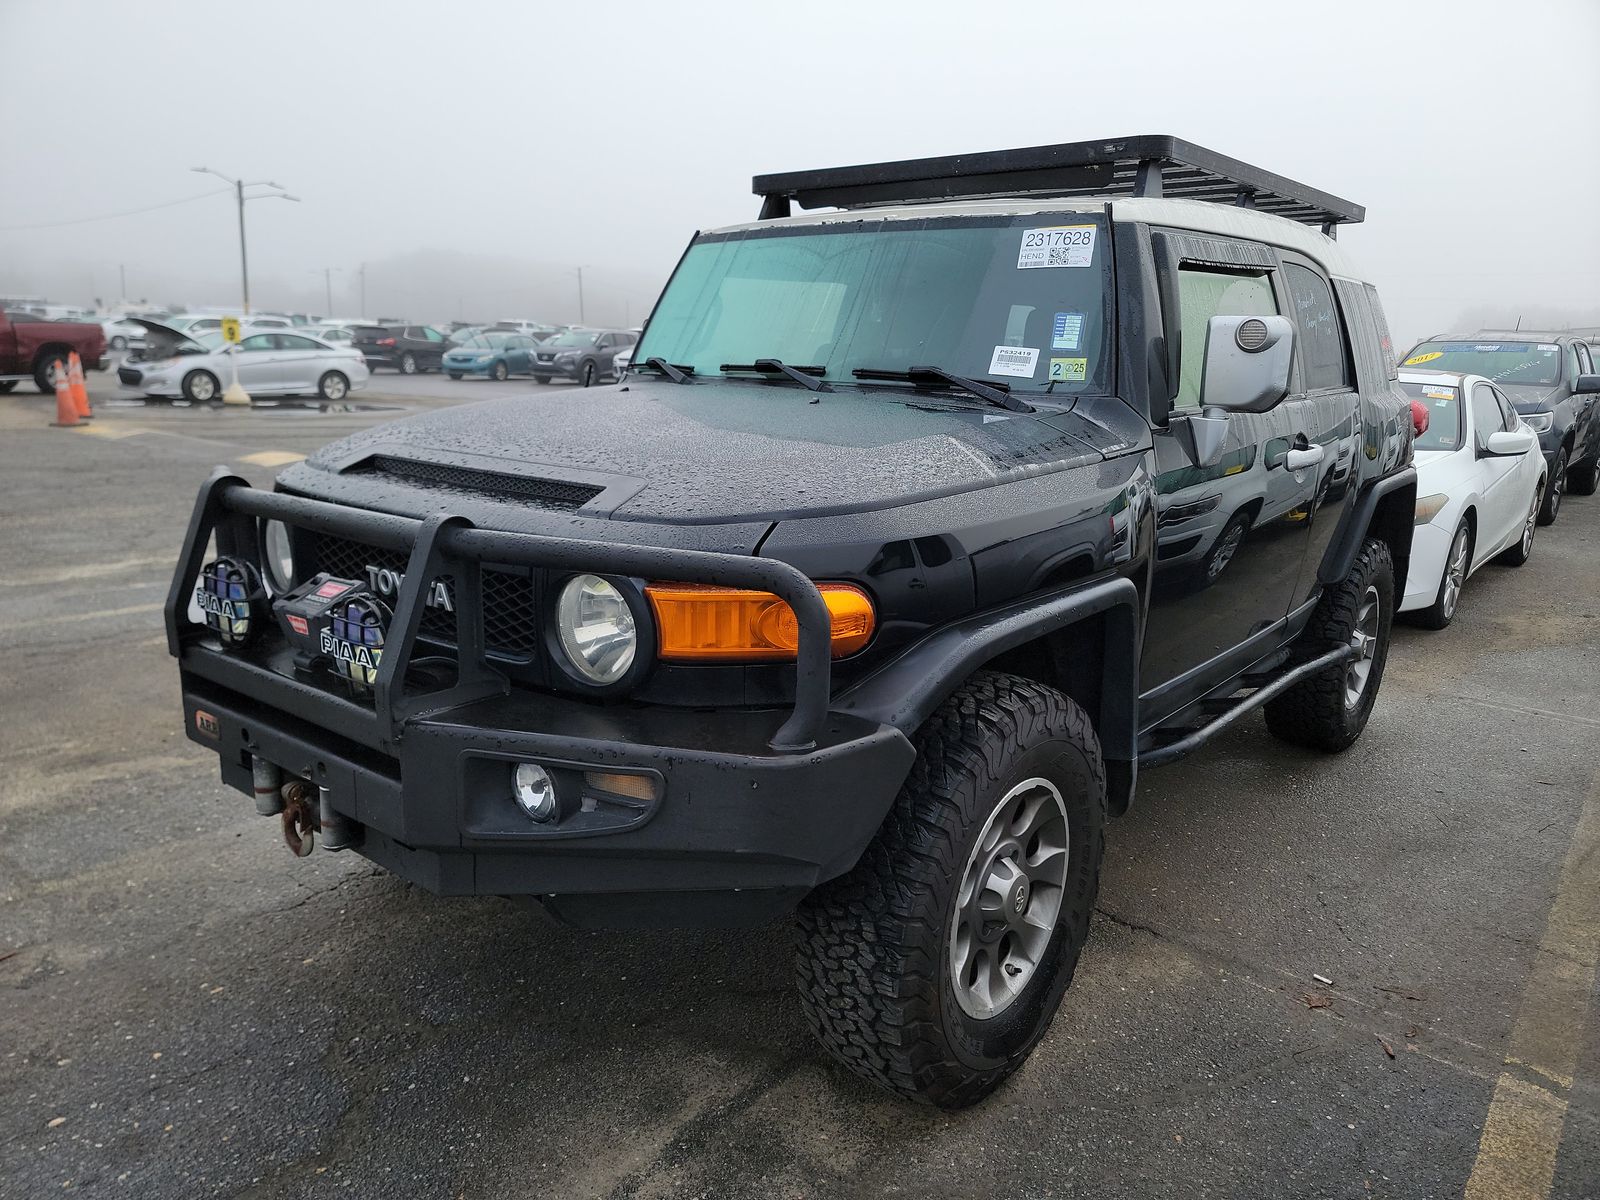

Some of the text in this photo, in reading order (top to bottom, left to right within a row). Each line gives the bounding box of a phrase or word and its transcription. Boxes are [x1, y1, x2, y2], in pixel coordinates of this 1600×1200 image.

[1026, 231, 1091, 247] 2317628
[1020, 252, 1045, 260] HEND
[1052, 363, 1085, 376] 2 25
[365, 564, 454, 612] TOYA
[320, 632, 374, 669] PIAA
